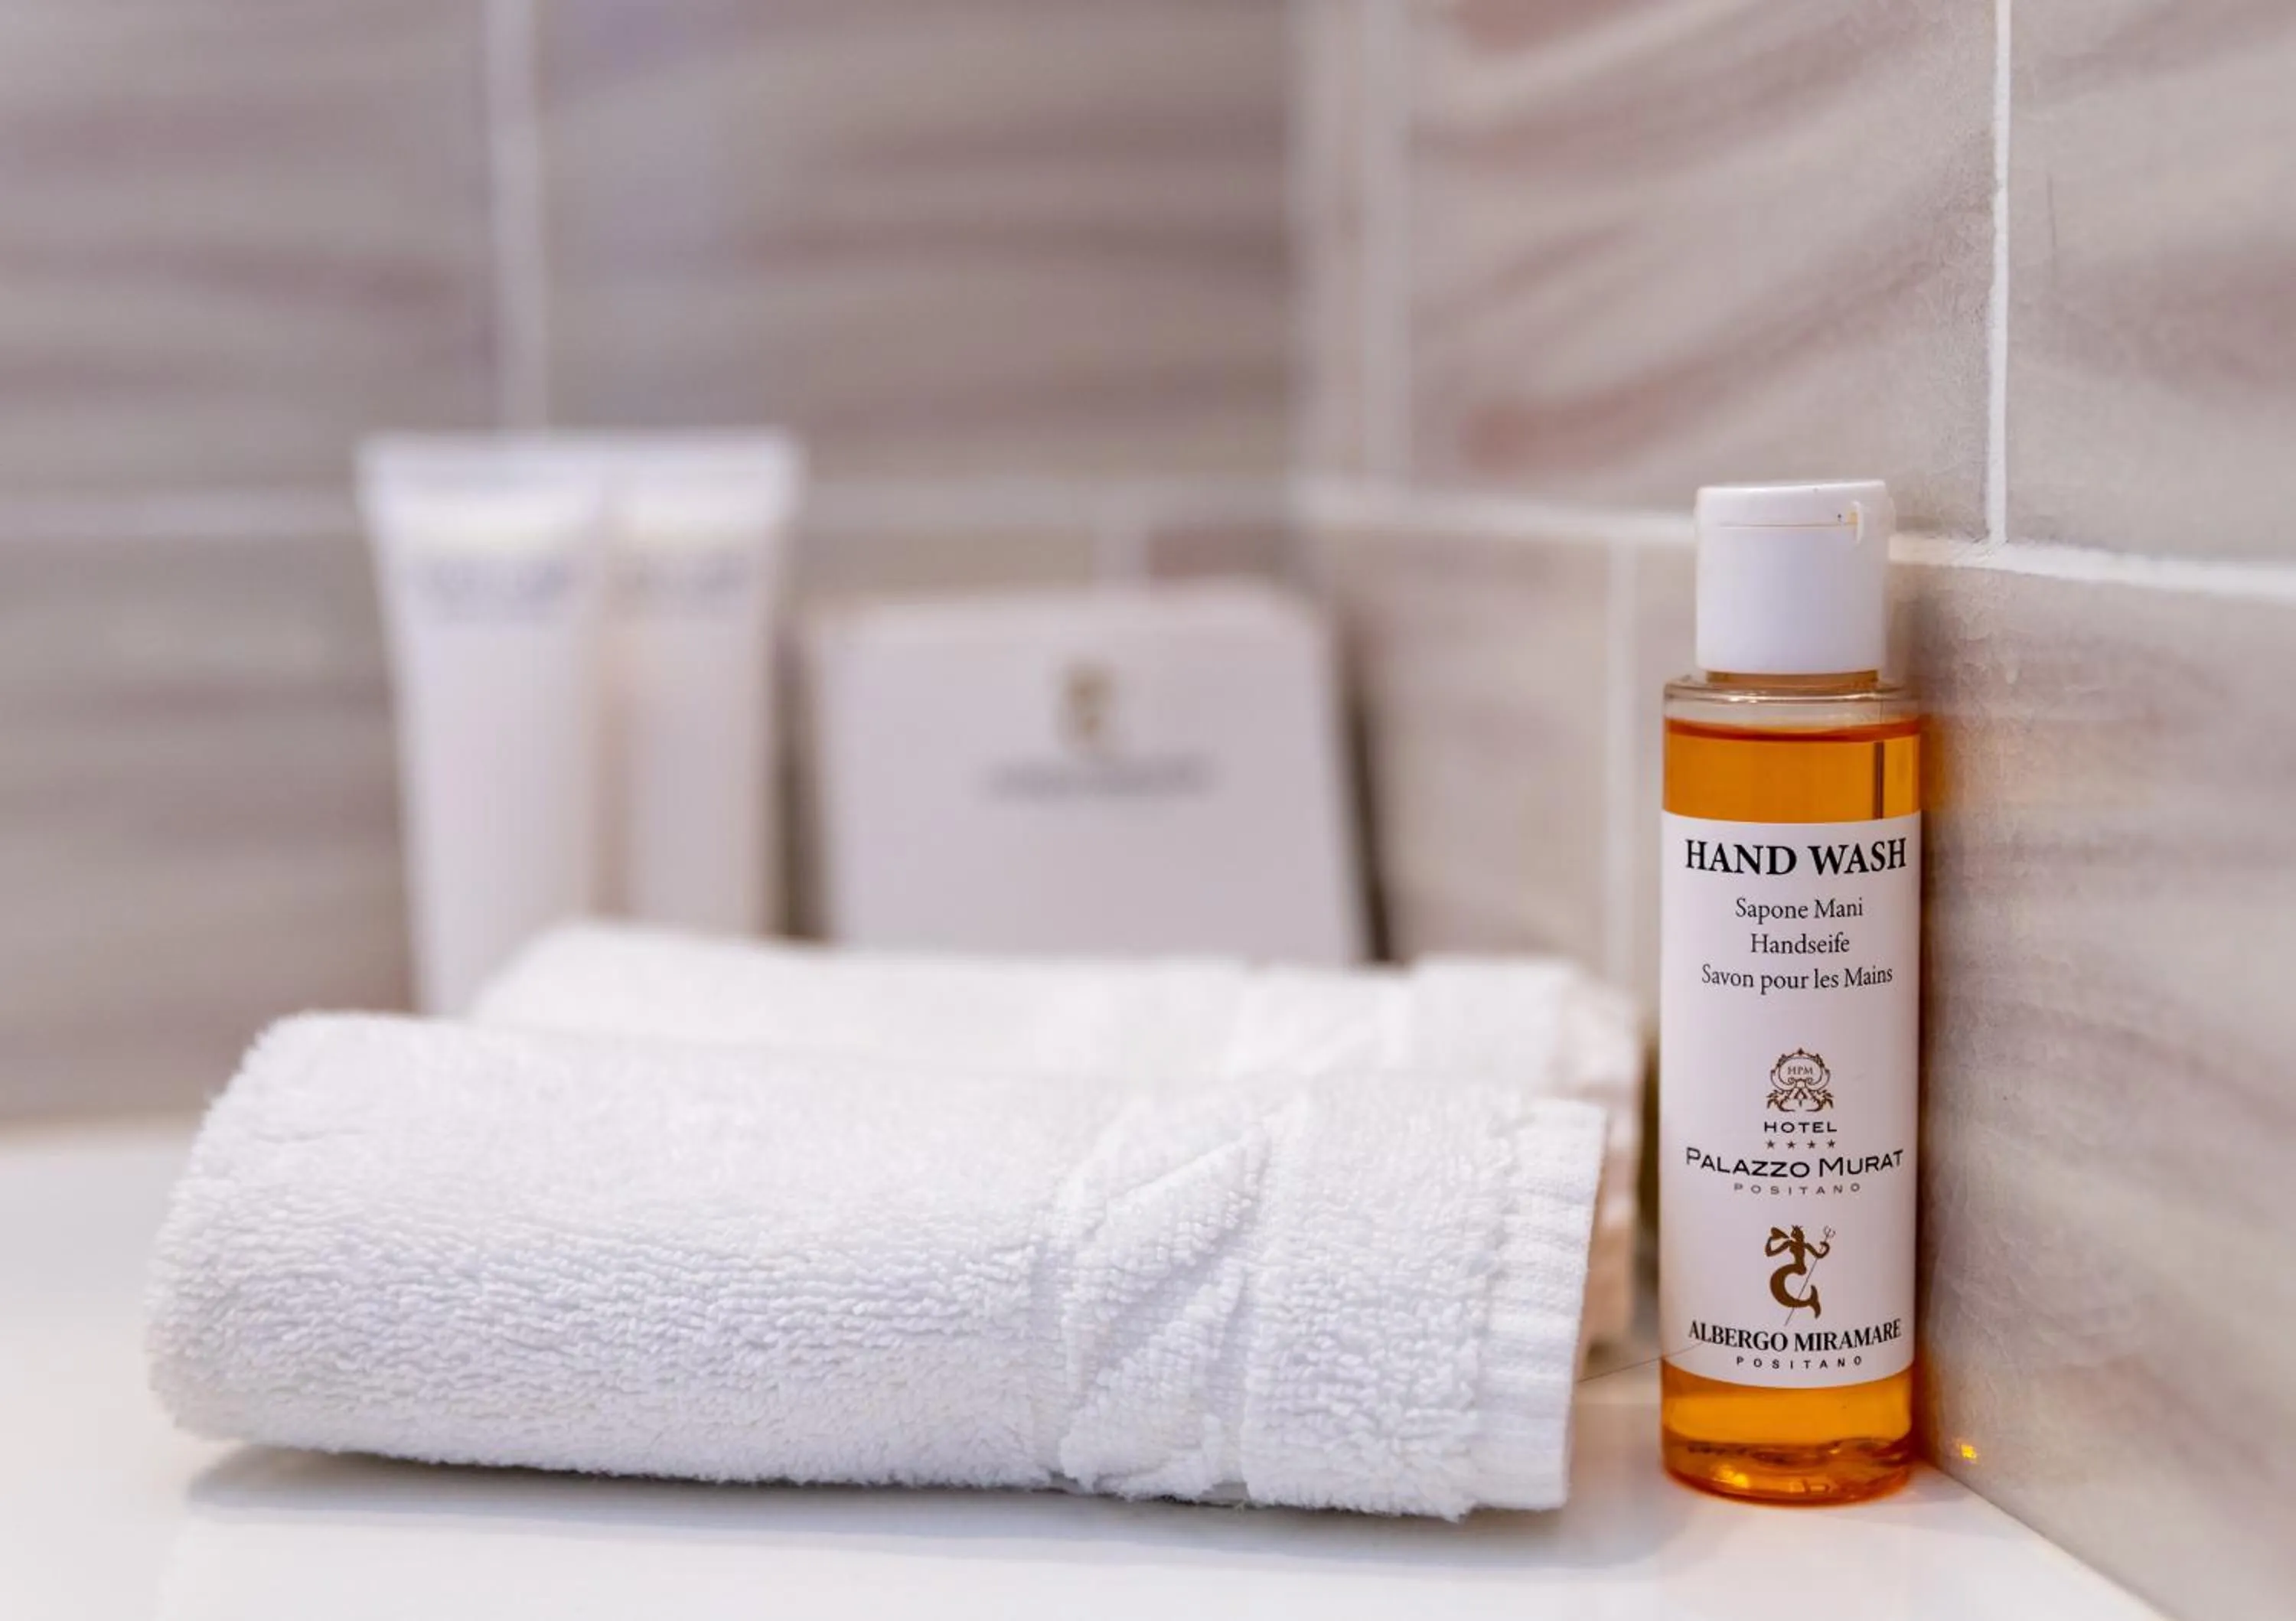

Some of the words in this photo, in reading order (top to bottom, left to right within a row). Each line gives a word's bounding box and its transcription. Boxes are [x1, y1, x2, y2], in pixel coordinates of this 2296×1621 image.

[1685, 840, 1797, 875] HAND
[1808, 838, 1906, 875] WASH
[1736, 896, 1808, 924] Sapone
[1814, 897, 1864, 918] Mani
[1751, 931, 1850, 954] Handseife
[1702, 964, 1753, 987] Savon
[1761, 973, 1808, 995] pour
[1815, 969, 1838, 988] les
[1844, 966, 1893, 987] Mains
[1787, 1066, 1813, 1075] HPM
[1764, 1121, 1837, 1133] HOTEL
[1686, 1147, 1810, 1177] PALAZZO
[1819, 1150, 1903, 1177] MURAT
[1734, 1182, 1861, 1194] POSITANO
[1688, 1320, 1788, 1352] ALBERGO
[1795, 1319, 1901, 1351] MIRAMARE
[1737, 1356, 1862, 1368] POSITANO
